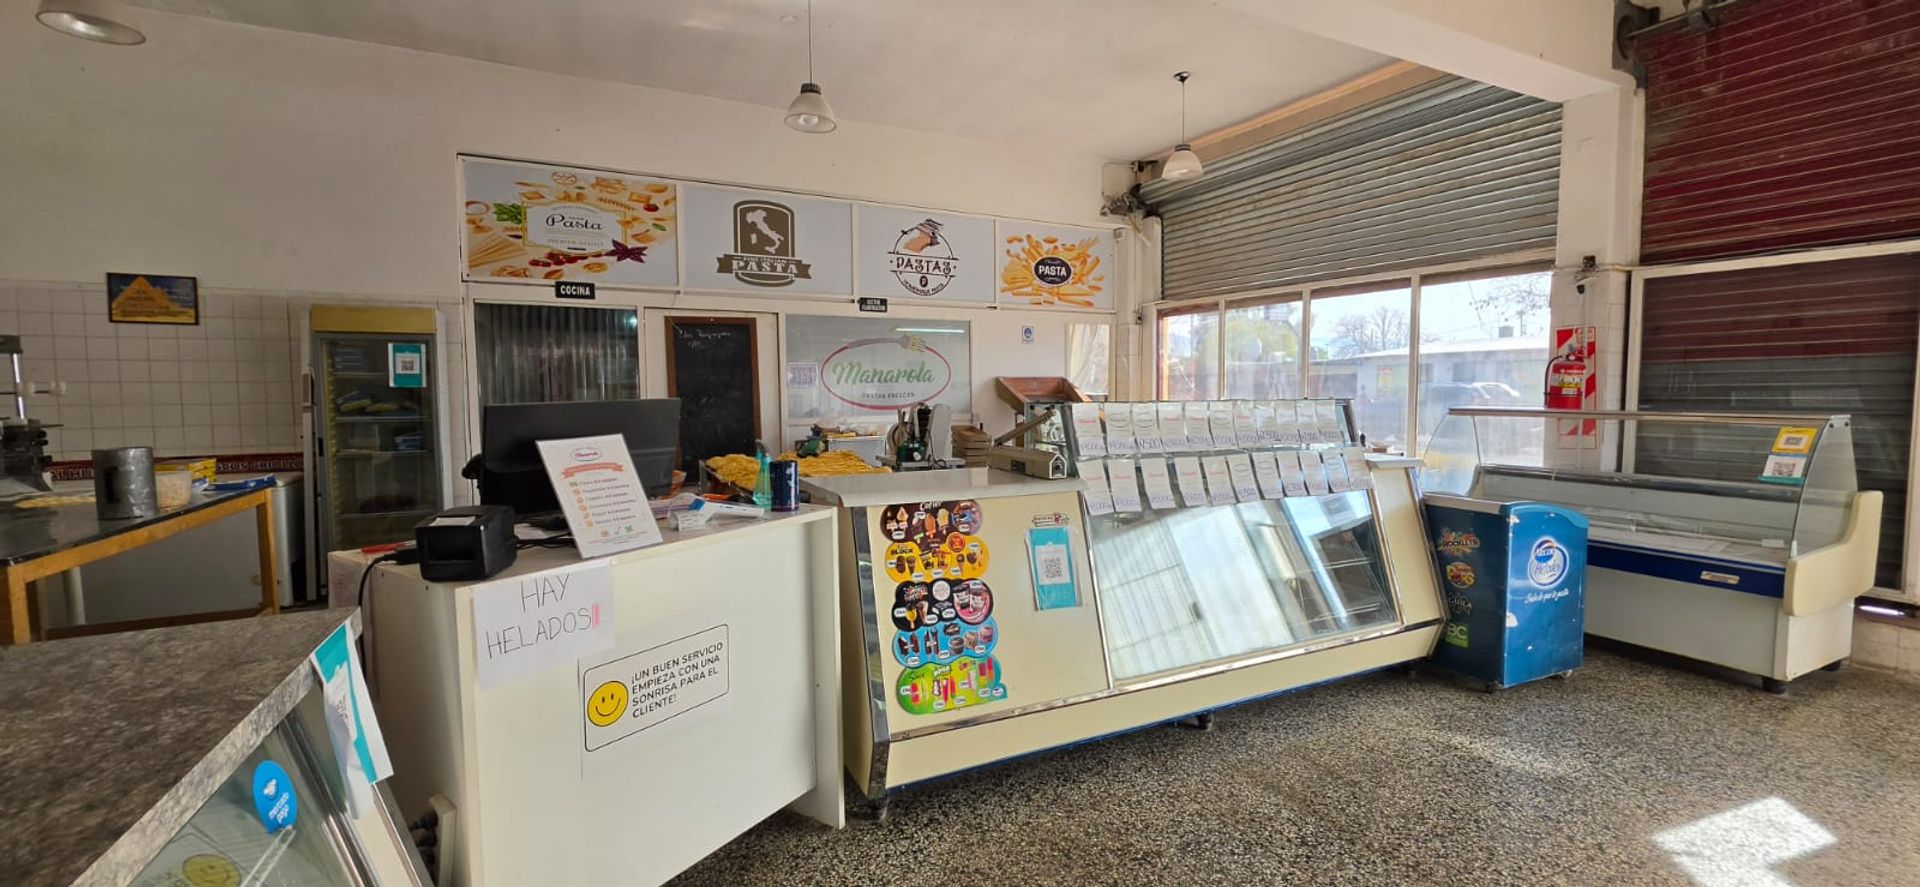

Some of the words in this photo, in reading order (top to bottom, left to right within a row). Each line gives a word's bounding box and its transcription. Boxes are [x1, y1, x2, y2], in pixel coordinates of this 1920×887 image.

[546, 214, 605, 230] Pasta
[732, 260, 798, 275] PASTA
[896, 257, 952, 275] PASTAS
[1038, 265, 1067, 277] PASTA
[560, 285, 591, 296] COCINA
[832, 361, 935, 385] Manarola
[519, 573, 571, 612] HAY
[485, 607, 592, 658] HELADOS
[632, 668, 650, 684] ¡UN
[652, 658, 680, 675] BUEN
[681, 642, 723, 664] SERVICIO
[632, 671, 676, 694] EMPIEZA
[678, 662, 699, 677] CON
[700, 655, 720, 668] UNA
[632, 682, 678, 707] SONRISA
[680, 671, 706, 688] PARA
[707, 667, 719, 677] EL
[632, 693, 677, 718] CLIENTE!
